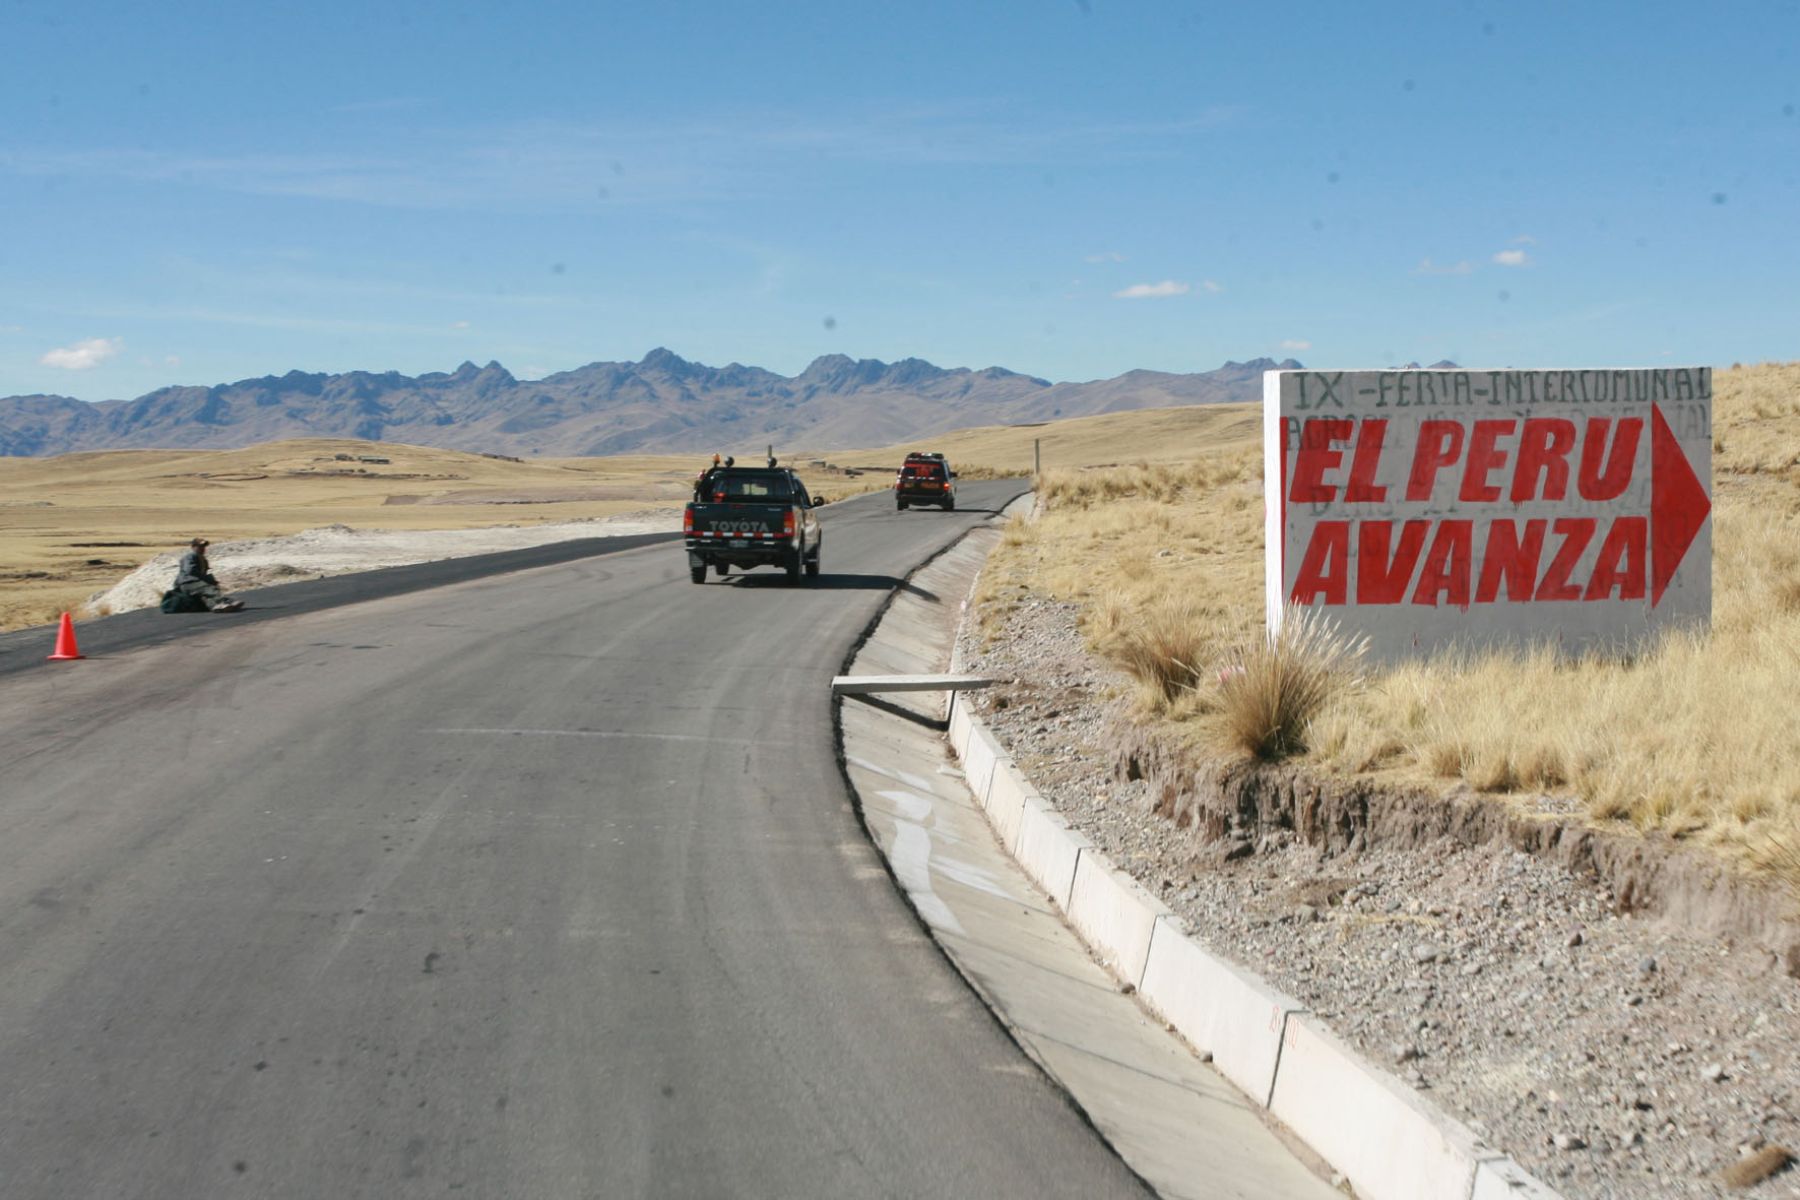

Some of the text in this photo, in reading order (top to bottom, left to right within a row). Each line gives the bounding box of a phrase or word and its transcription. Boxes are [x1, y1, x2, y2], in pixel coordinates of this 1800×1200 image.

[1289, 418, 1389, 502] EL
[1405, 417, 1644, 503] PERU
[709, 520, 769, 533] TOYOTA
[1290, 516, 1648, 606] AVANZA
